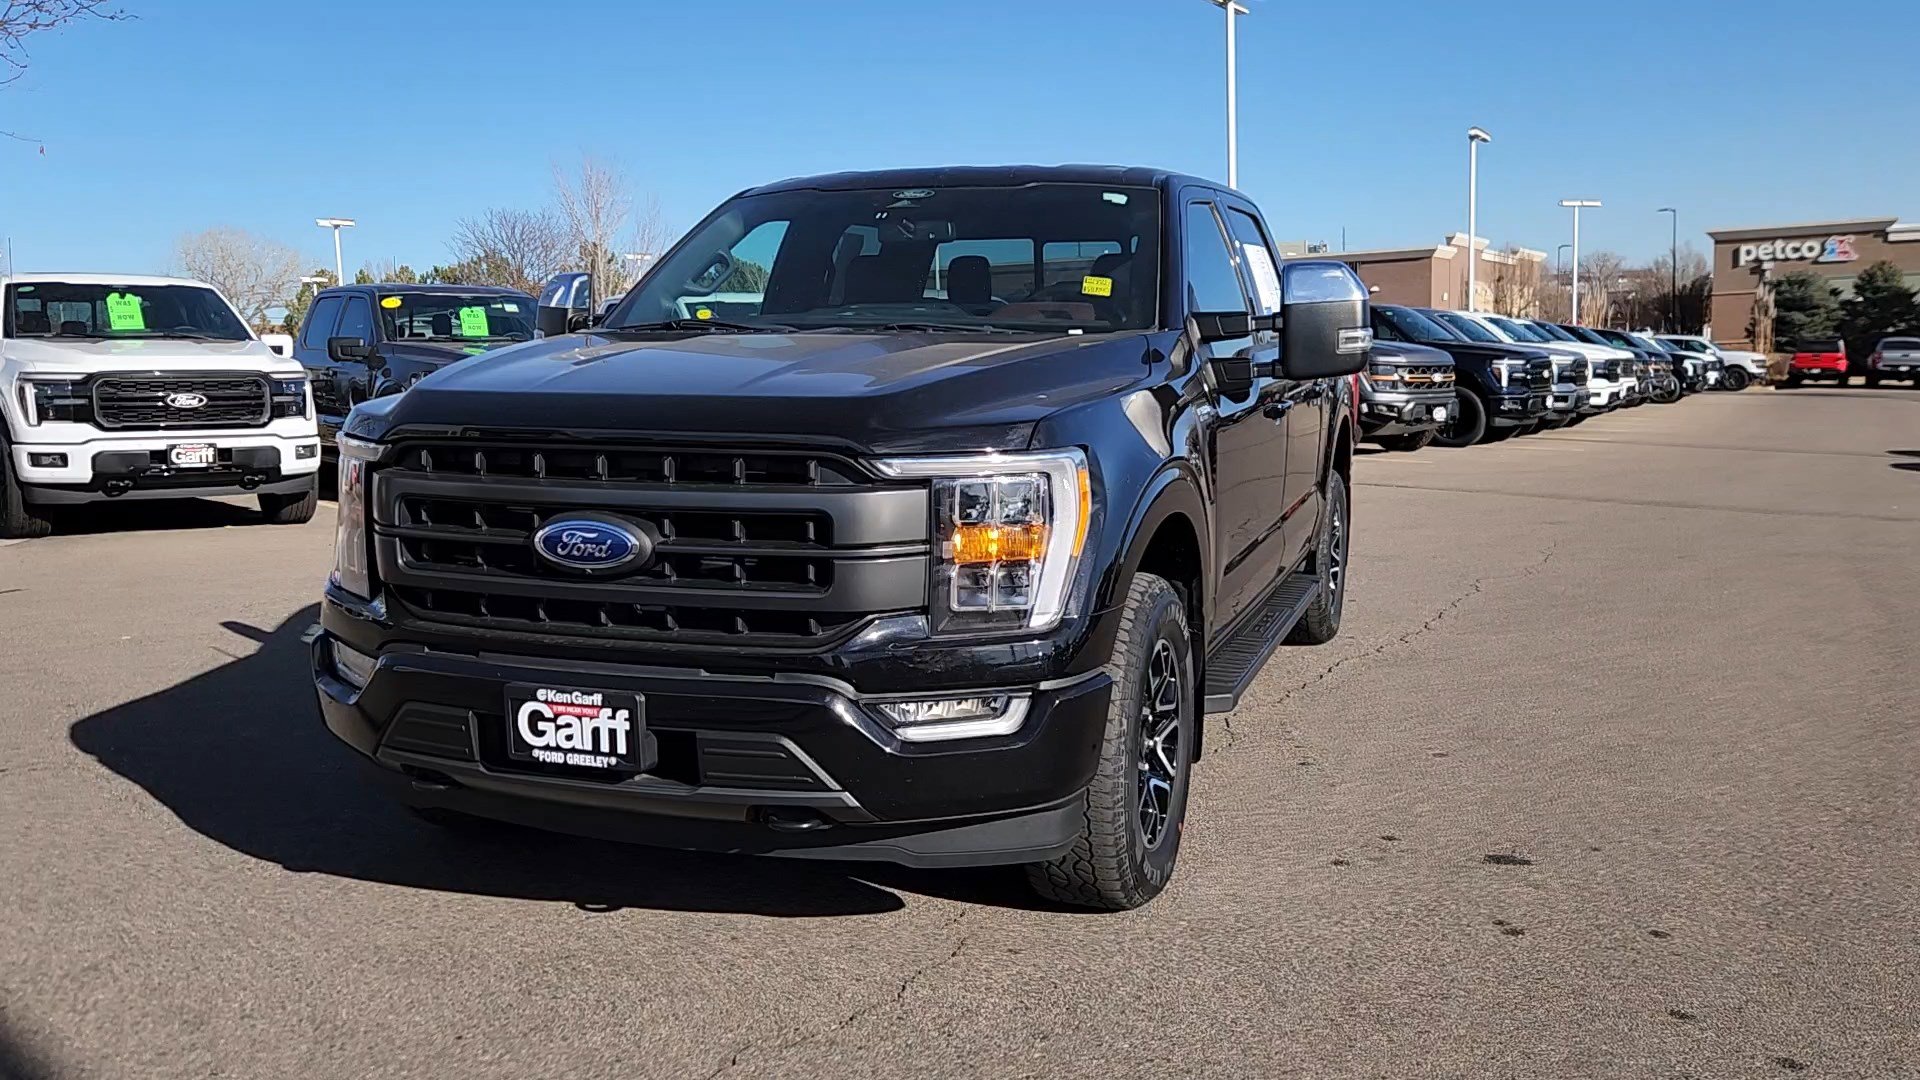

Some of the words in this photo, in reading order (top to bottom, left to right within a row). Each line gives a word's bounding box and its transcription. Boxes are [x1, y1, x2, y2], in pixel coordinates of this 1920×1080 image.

[1739, 239, 1821, 266] petco
[174, 394, 200, 406] Ford
[171, 447, 215, 464] Garff
[556, 529, 612, 558] Ford
[517, 701, 630, 755] Garff
[539, 750, 565, 764] FORD
[566, 752, 609, 769] GREELEY
